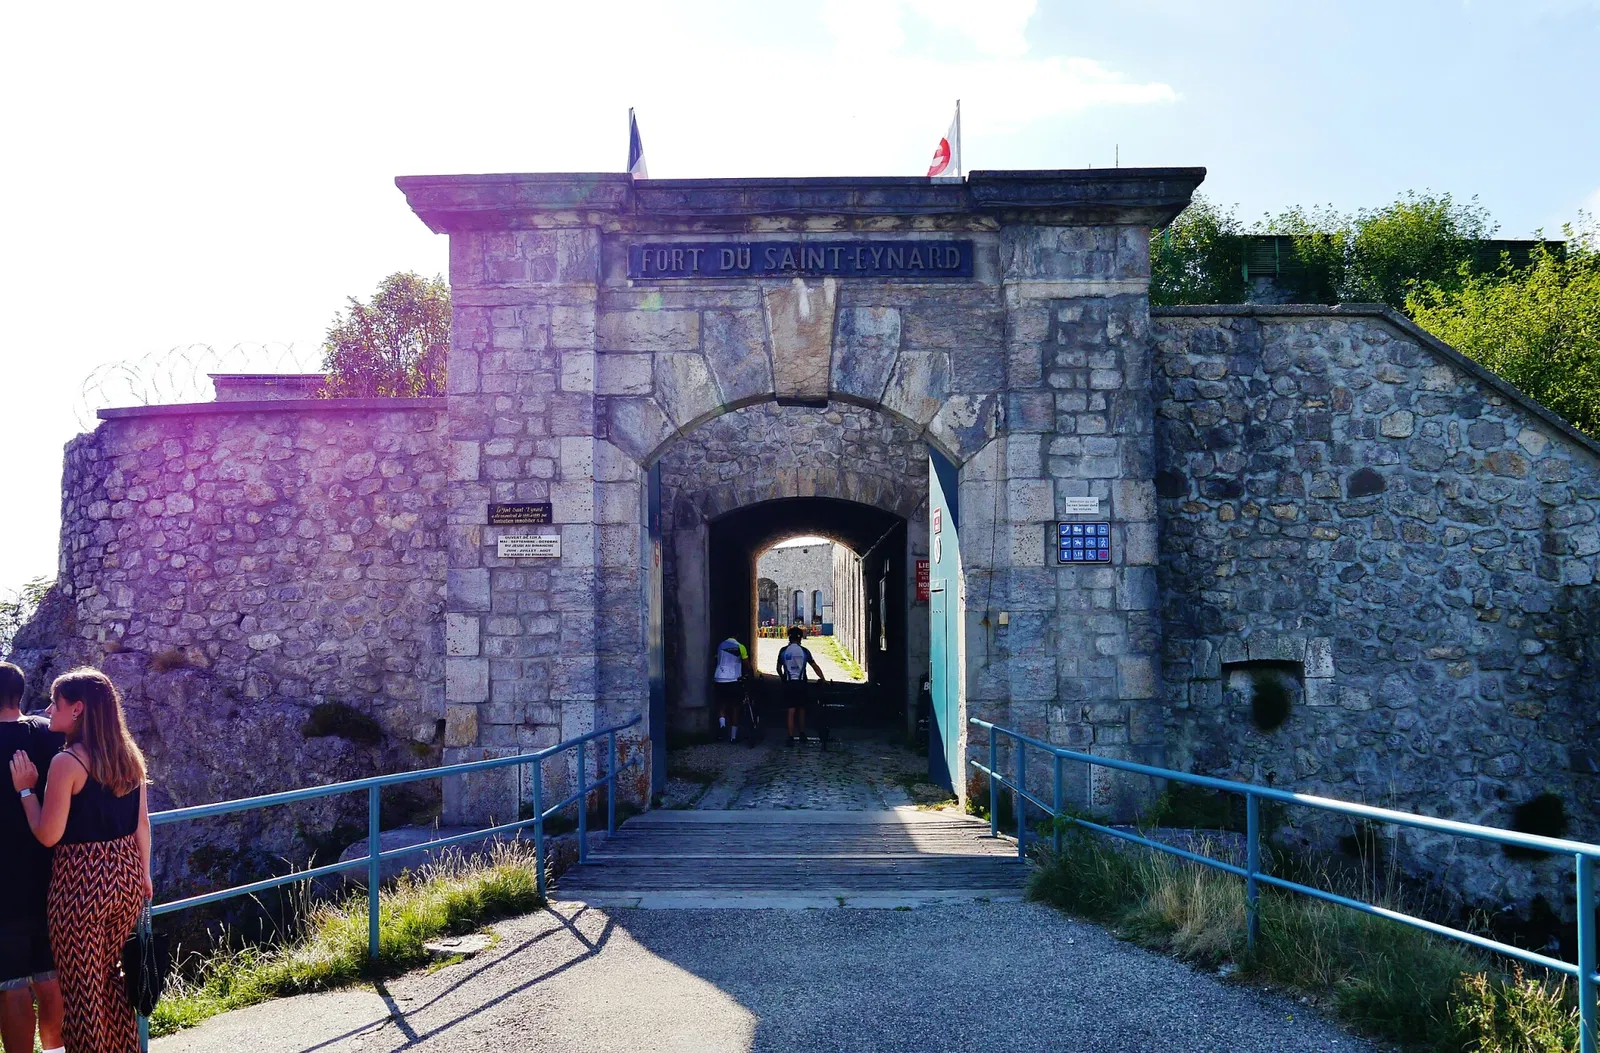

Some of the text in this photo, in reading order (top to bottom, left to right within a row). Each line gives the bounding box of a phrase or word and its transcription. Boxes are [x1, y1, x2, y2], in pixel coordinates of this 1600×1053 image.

[642, 246, 961, 271] FORT DU SAINT-EYNARD
